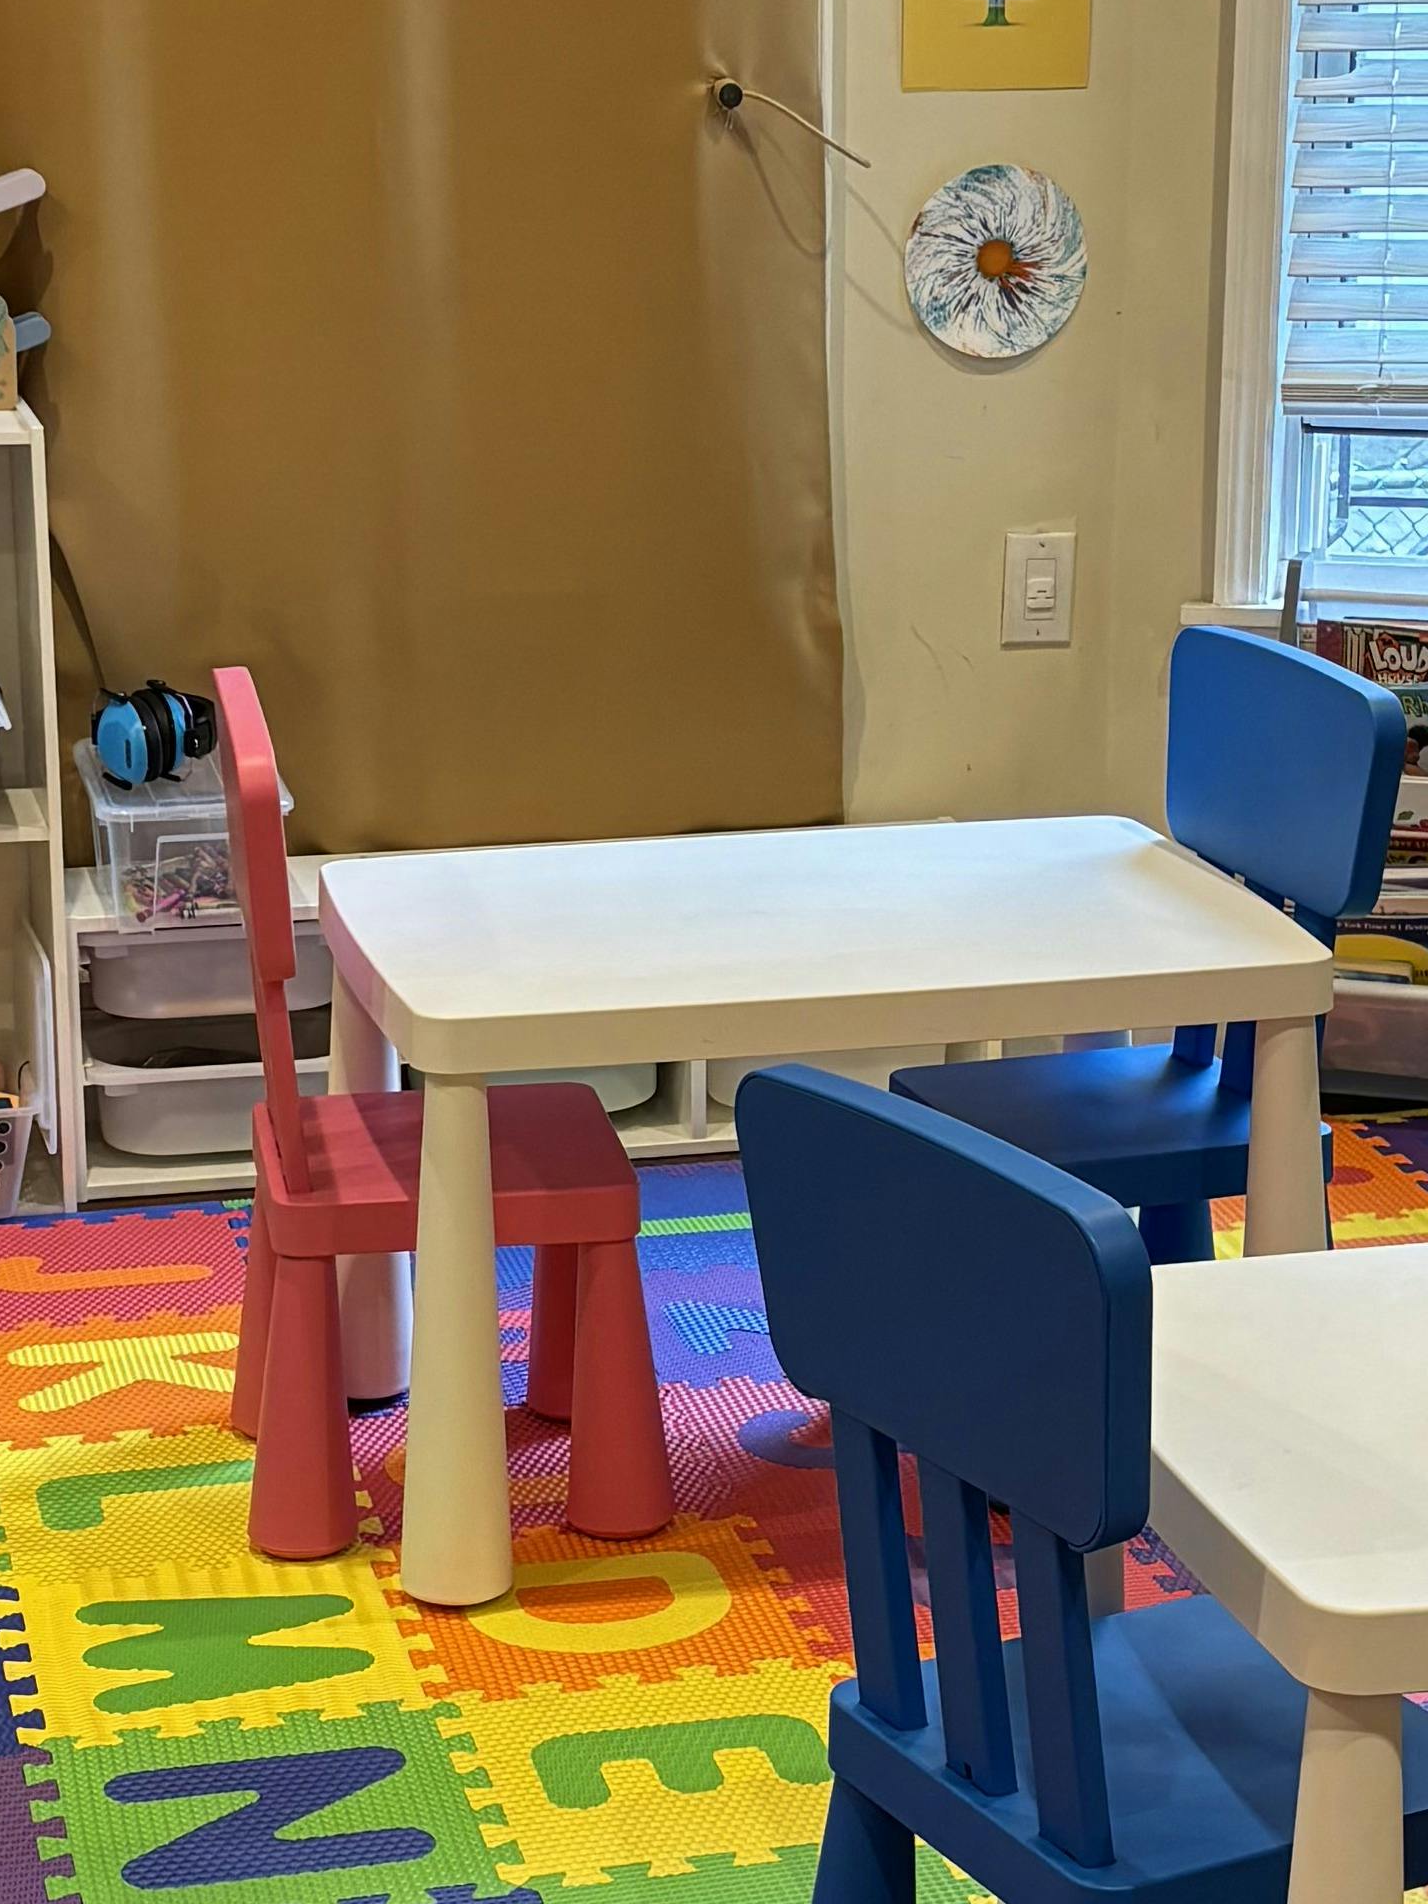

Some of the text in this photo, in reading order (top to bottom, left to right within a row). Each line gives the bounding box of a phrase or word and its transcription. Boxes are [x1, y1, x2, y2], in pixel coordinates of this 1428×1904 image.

[6, 1331, 240, 1413] K
[74, 1593, 376, 1716] M
[530, 1713, 834, 1810] E
[103, 1747, 437, 1890] N
